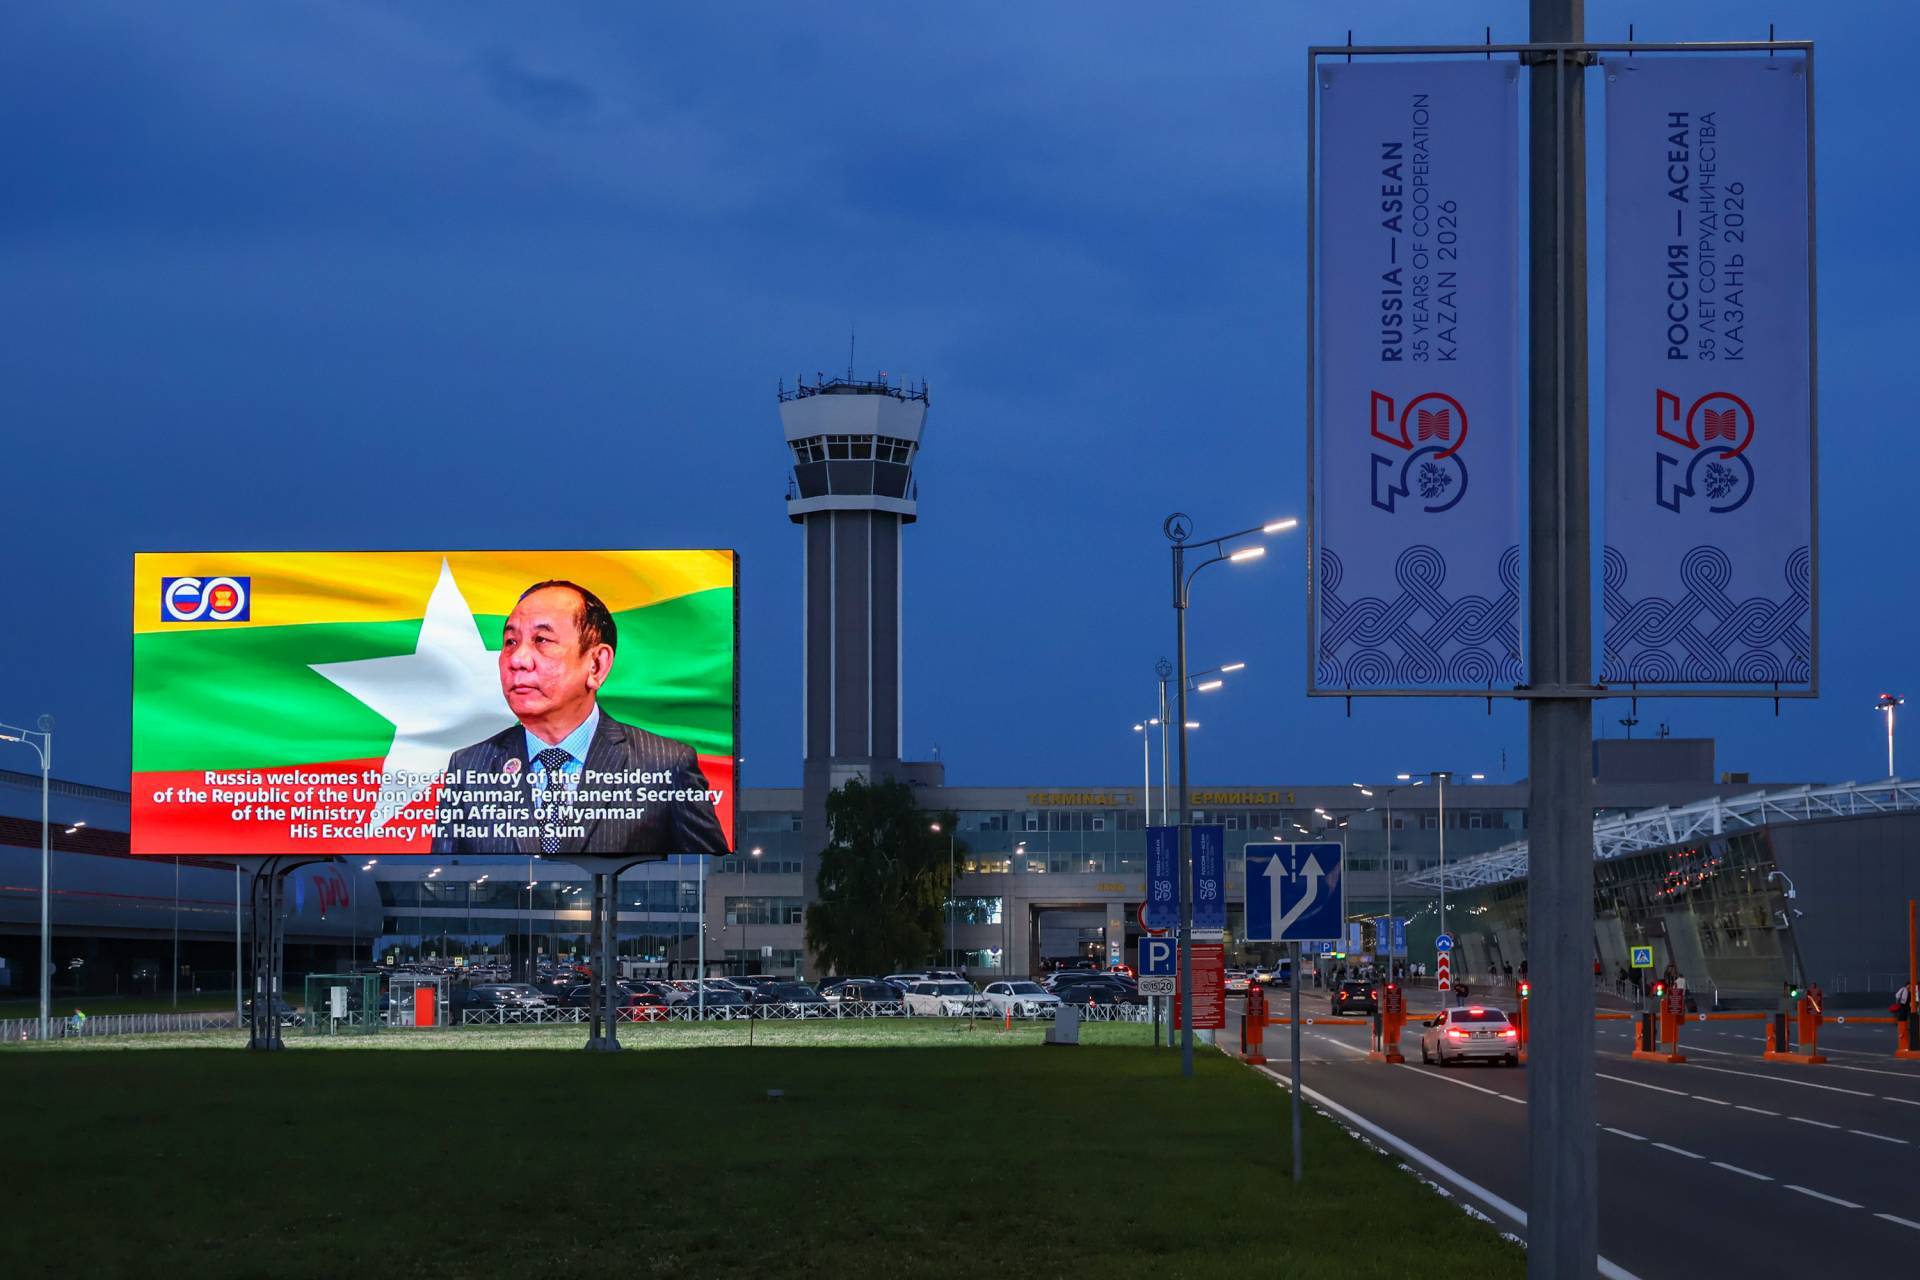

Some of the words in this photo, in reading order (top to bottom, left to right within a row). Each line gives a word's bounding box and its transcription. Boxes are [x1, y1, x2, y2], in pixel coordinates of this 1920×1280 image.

[1412, 93, 1430, 238] COOPERATION
[1667, 111, 1690, 204] АСЕАН
[1698, 111, 1718, 294] СОТРУДНИЧЕСТВА
[1724, 181, 1745, 244] 2026
[1437, 200, 1457, 261] 2026
[1412, 243, 1430, 270] OF
[1412, 274, 1430, 335] YEARS
[1437, 271, 1457, 361] KAZAN
[1667, 244, 1690, 360] РОССИЯ
[1698, 298, 1717, 333] ЛЕТ
[1724, 253, 1745, 361] КАЗАНЬ
[1412, 339, 1430, 363] 35
[1698, 338, 1717, 362] 35
[204, 770, 262, 786] Russia
[266, 770, 358, 786] welcomes
[361, 770, 393, 785] the
[396, 770, 461, 789] Special
[465, 770, 522, 789] Envoy
[526, 769, 546, 785] of
[550, 769, 581, 785] the
[585, 769, 672, 785] President
[153, 787, 173, 803] of
[177, 787, 208, 803] the
[211, 787, 291, 806] Republic
[294, 787, 314, 803] of
[318, 787, 349, 803] the
[352, 787, 407, 802] Union
[411, 786, 431, 802] of
[435, 788, 525, 806] Myanmar,
[531, 787, 634, 802] Permanent
[637, 787, 724, 805] Secretary
[1026, 792, 1117, 806] TERMINAL
[1190, 792, 1280, 806] ЕРМИНАЛ
[1286, 792, 1296, 805] 1
[231, 804, 252, 821] of
[255, 805, 286, 820] the
[290, 805, 365, 824] Ministry
[369, 804, 389, 820] of
[394, 805, 464, 823] Foreign
[468, 804, 530, 820] Affairs
[533, 804, 553, 820] of
[558, 805, 645, 824] Myanmar
[289, 823, 318, 838] His
[321, 823, 416, 842] Excellency
[420, 823, 449, 838] Mr.
[453, 823, 489, 838] Hau
[493, 822, 540, 838] Khan
[543, 822, 585, 838] Sum
[1150, 941, 1170, 971] P
[1160, 982, 1172, 991] 20
